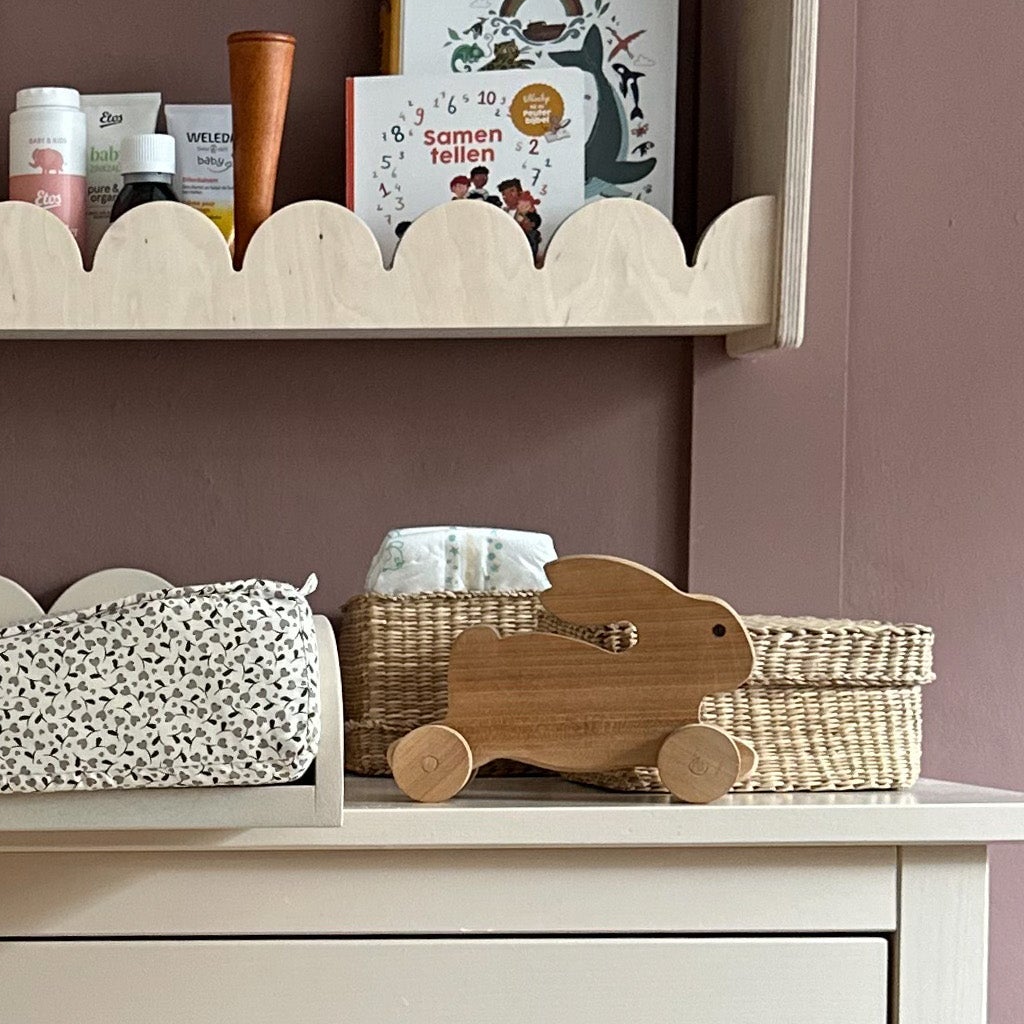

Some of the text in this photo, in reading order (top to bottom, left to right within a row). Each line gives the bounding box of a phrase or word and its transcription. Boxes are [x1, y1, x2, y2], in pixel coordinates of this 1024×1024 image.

[447, 96, 457, 114] 6
[477, 91, 496, 105] 10
[99, 111, 123, 128] Etos
[414, 107, 425, 126] 9
[186, 132, 233, 143] WELED
[391, 125, 405, 143] 8
[424, 128, 502, 146] Samen
[90, 146, 119, 161] bab
[528, 139, 539, 155] 2
[197, 156, 224, 167] baby
[380, 155, 392, 169] 5
[431, 146, 495, 164] tellen
[532, 167, 541, 186] 7
[88, 185, 110, 195] pure
[379, 183, 391, 198] 1
[539, 184, 548, 195] 3
[35, 189, 62, 209] Etos
[395, 197, 405, 211] 3
